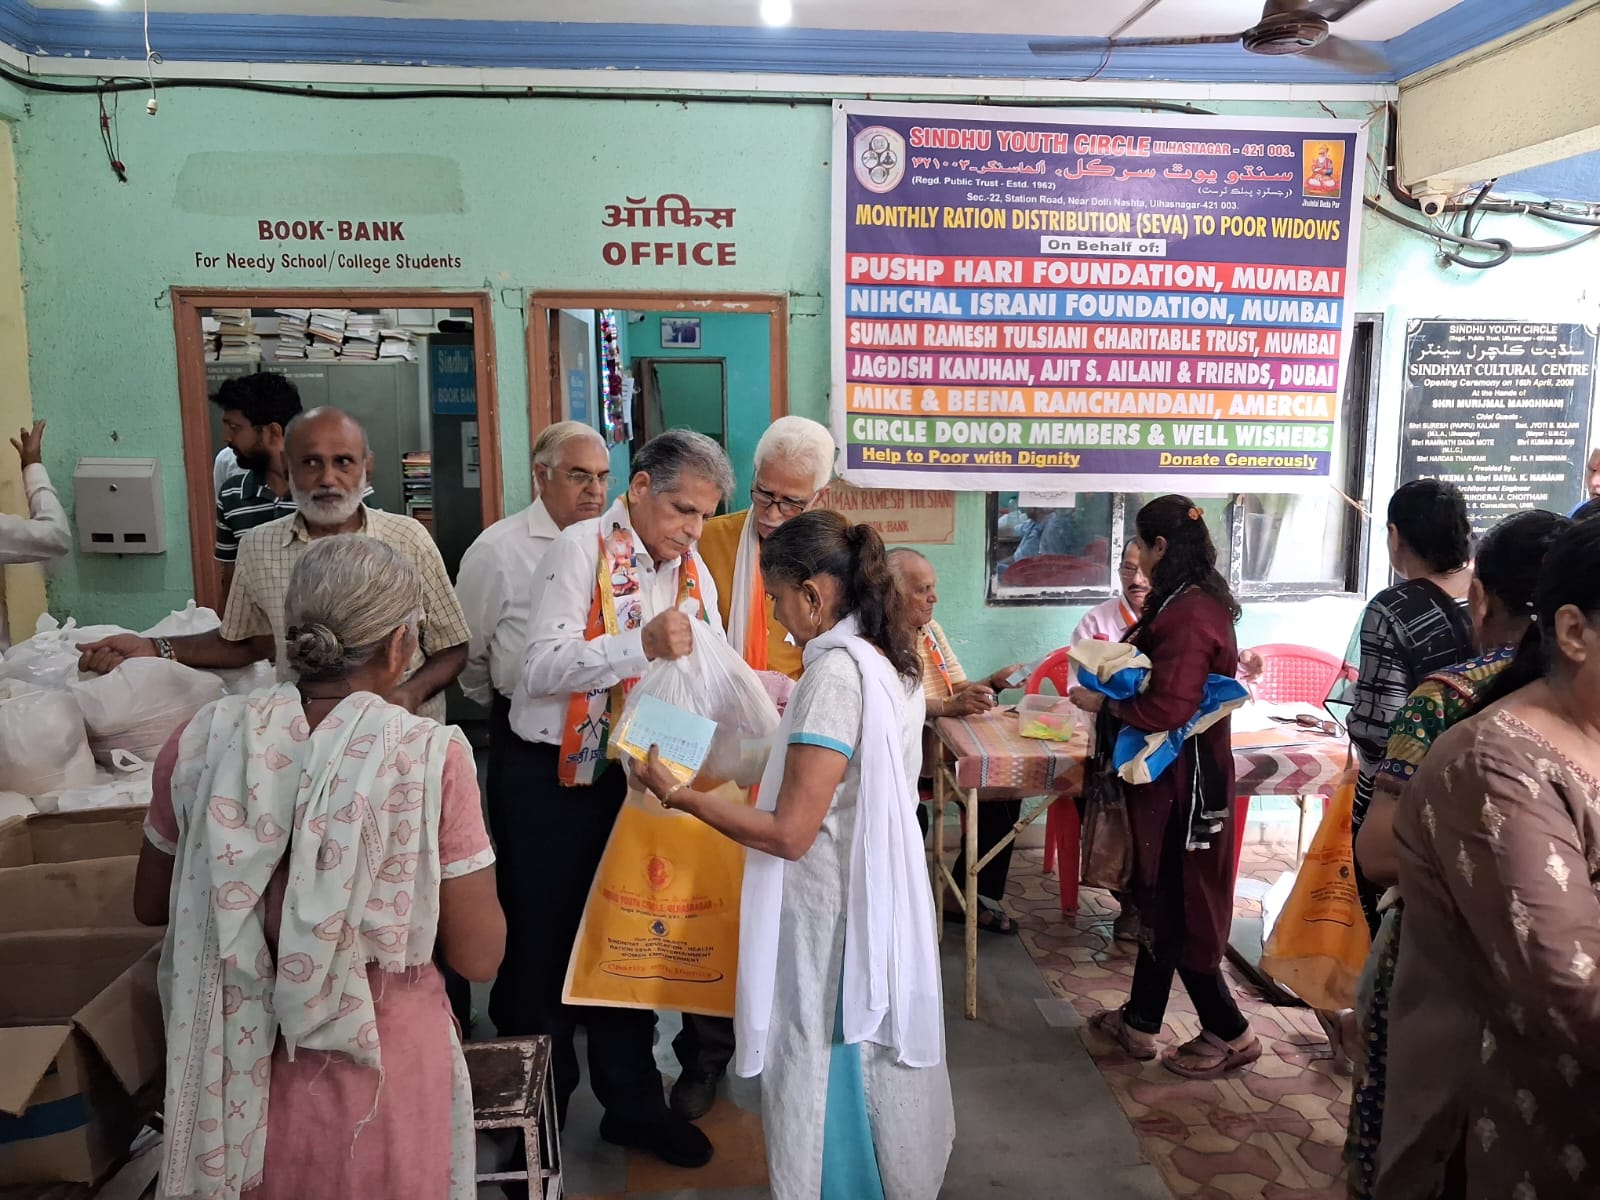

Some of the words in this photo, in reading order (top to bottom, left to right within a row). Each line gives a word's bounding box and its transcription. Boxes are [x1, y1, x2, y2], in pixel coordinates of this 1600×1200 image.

[910, 126, 991, 150] SINDHU
[997, 131, 1069, 154] YOUTH
[1074, 134, 1151, 157] CIRCLE
[1152, 140, 1232, 156] ULHASNAGAR
[1242, 144, 1266, 157] 421
[1268, 144, 1295, 157] 003.
[911, 175, 942, 186] (Regd.
[944, 176, 973, 187] Public
[975, 178, 998, 188] Trust
[1006, 179, 1029, 188] Estd.
[1032, 180, 1056, 190] 1962)
[601, 193, 737, 230] ऑफिस
[966, 192, 1003, 204] Sec.-22,
[1004, 193, 1038, 204] Station
[1039, 194, 1066, 205] Road,
[1068, 196, 1089, 206] Near
[1113, 198, 1148, 208] Nashta,
[1150, 199, 1218, 211] Ulhasnagar-421
[1220, 201, 1240, 210] 003.
[257, 219, 406, 242] BOOK-BANK
[855, 203, 939, 228] MONTHLY
[943, 206, 1007, 229] RATION
[1012, 208, 1131, 233] DISTRIBUTION
[1136, 213, 1189, 240] (SEVA)
[1193, 215, 1216, 236] TO
[1220, 216, 1267, 238] POOR
[1271, 217, 1340, 241] WIDOWS
[602, 241, 737, 266] OFFICE
[1048, 239, 1071, 251] On
[1077, 240, 1133, 252] Behalf
[1139, 241, 1160, 253] of:
[195, 251, 220, 269] For
[226, 252, 275, 273] Needy
[281, 250, 390, 273] School/College
[395, 252, 462, 270] Students
[851, 256, 945, 282] PUSHP
[953, 260, 1023, 283] HARI
[1033, 260, 1225, 293] FOUNDATION,
[1231, 267, 1340, 293] MUMBAI
[850, 289, 962, 315] NIHCHAL
[970, 293, 1057, 316] ISRANI
[1065, 293, 1235, 325] FOUNDATION,
[1240, 299, 1338, 324] MUMBAI
[850, 321, 917, 346] SUMAN
[923, 324, 998, 348] RAMESH
[1003, 326, 1088, 349] TULSIANI
[1093, 326, 1201, 351] CHARITABLE
[1206, 329, 1260, 358] TRUST,
[1264, 332, 1336, 356] MUMBAI
[1449, 325, 1487, 334] SINDHU
[1489, 325, 1520, 334] YOUTH
[1522, 325, 1558, 334] CIRCLE
[852, 354, 933, 379] JAGDISH
[939, 357, 1035, 386] KANJHAN,
[1040, 359, 1082, 382] AJIT
[1085, 359, 1102, 383] S.
[1107, 360, 1172, 383] AILANI
[1177, 361, 1192, 383] &
[1196, 361, 1276, 390] FRIENDS,
[1280, 364, 1335, 387] DUBAI
[1410, 363, 1472, 376] SINDHYAT
[1474, 363, 1538, 376] CULTURAL
[1541, 363, 1589, 376] CENTRE
[1424, 378, 1457, 388] Opening
[1460, 378, 1500, 388] Ceremony
[1472, 389, 1480, 397] At
[1481, 389, 1493, 397] the
[1519, 389, 1527, 397] of
[438, 387, 461, 404] BOOK
[852, 386, 913, 411] MIKE
[920, 388, 940, 411] &
[947, 389, 1026, 413] BEENA
[1033, 390, 1222, 420] RAMCHANDANI,
[1228, 393, 1329, 418] AMERCIA
[1432, 399, 1455, 408] SHRI
[852, 417, 927, 443] CIRCLE
[935, 421, 1022, 445] DONOR
[1029, 422, 1141, 446] MEMBERS
[1147, 423, 1165, 446] &
[1172, 424, 1229, 447] WELL
[1235, 425, 1329, 448] WISHERS
[862, 447, 901, 464] Help
[906, 449, 924, 463] to
[929, 449, 969, 464] Poor
[973, 450, 1012, 464] with
[1018, 451, 1081, 468] Dignity
[1159, 452, 1220, 467] Donate
[1225, 453, 1317, 471] Generously
[861, 489, 905, 511] RAMESH
